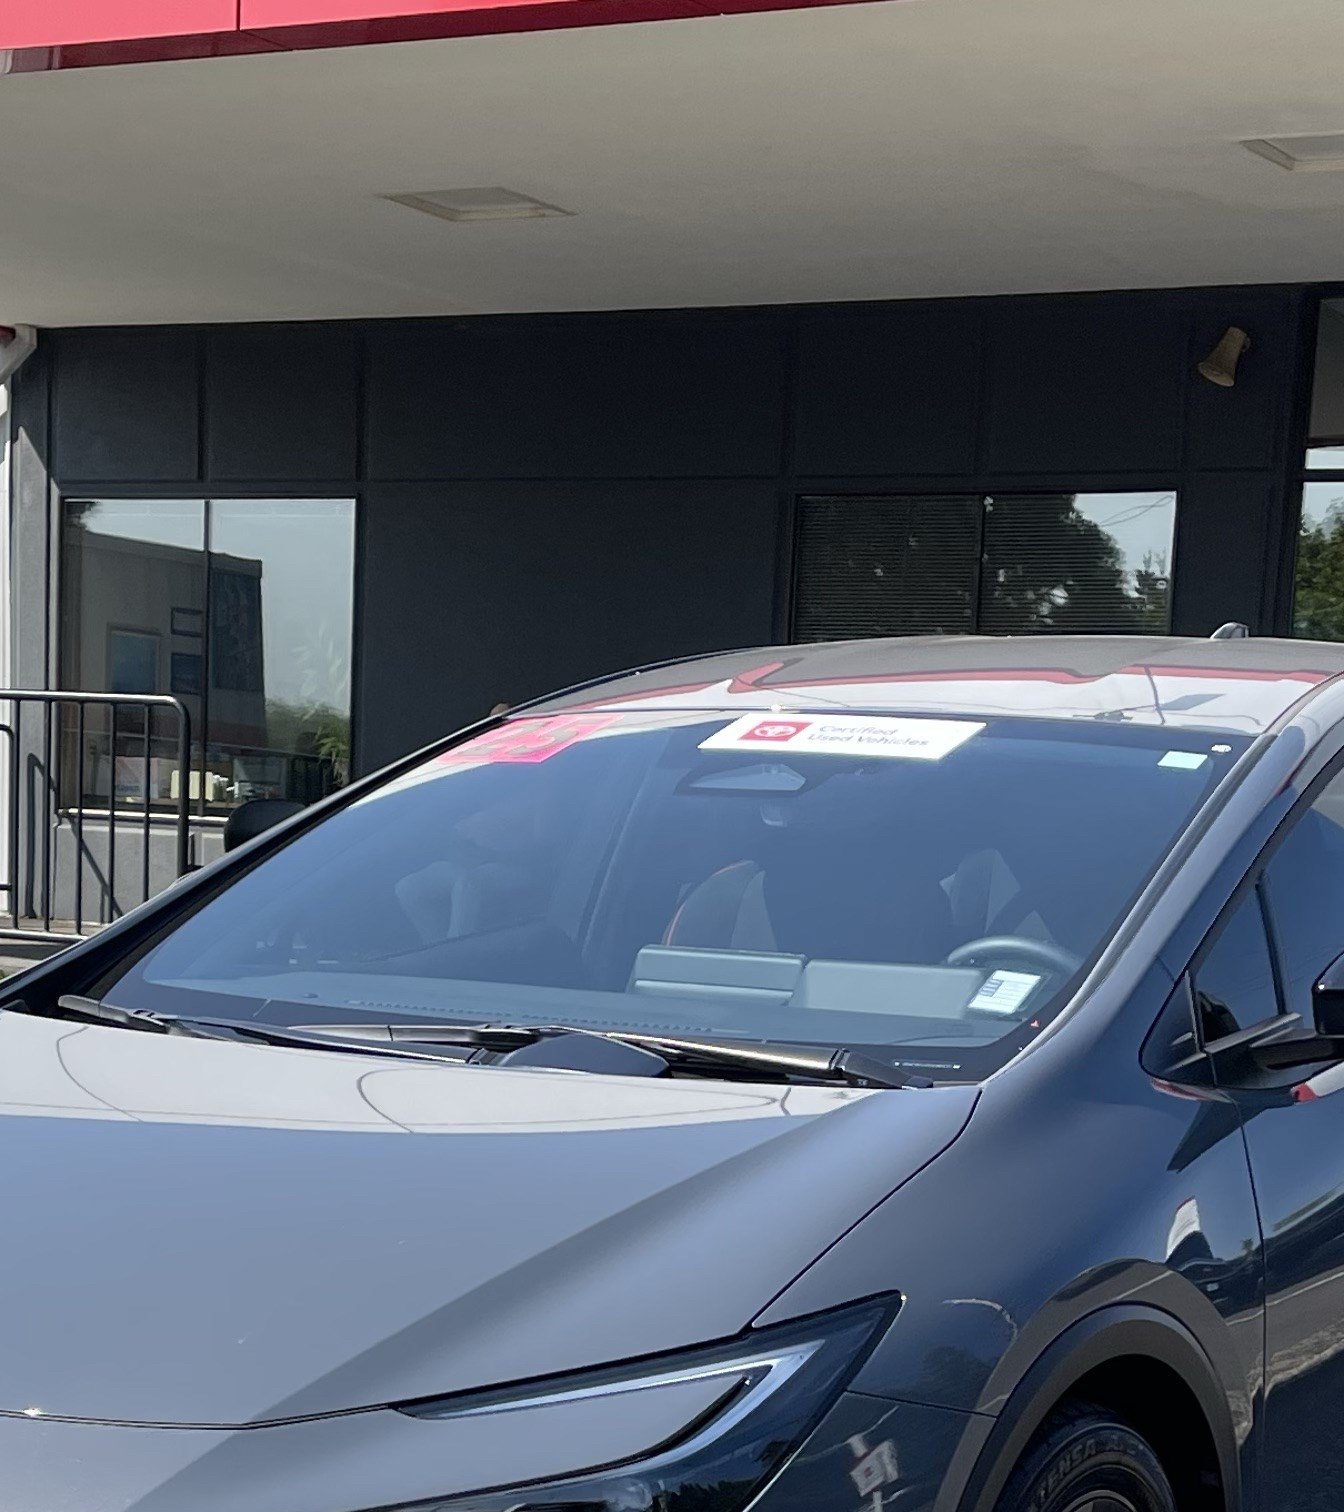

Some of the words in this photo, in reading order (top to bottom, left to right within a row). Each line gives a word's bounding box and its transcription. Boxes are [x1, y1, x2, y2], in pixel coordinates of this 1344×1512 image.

[818, 724, 899, 737] Certified
[807, 733, 855, 743] Used
[857, 734, 930, 746] Vehicles
